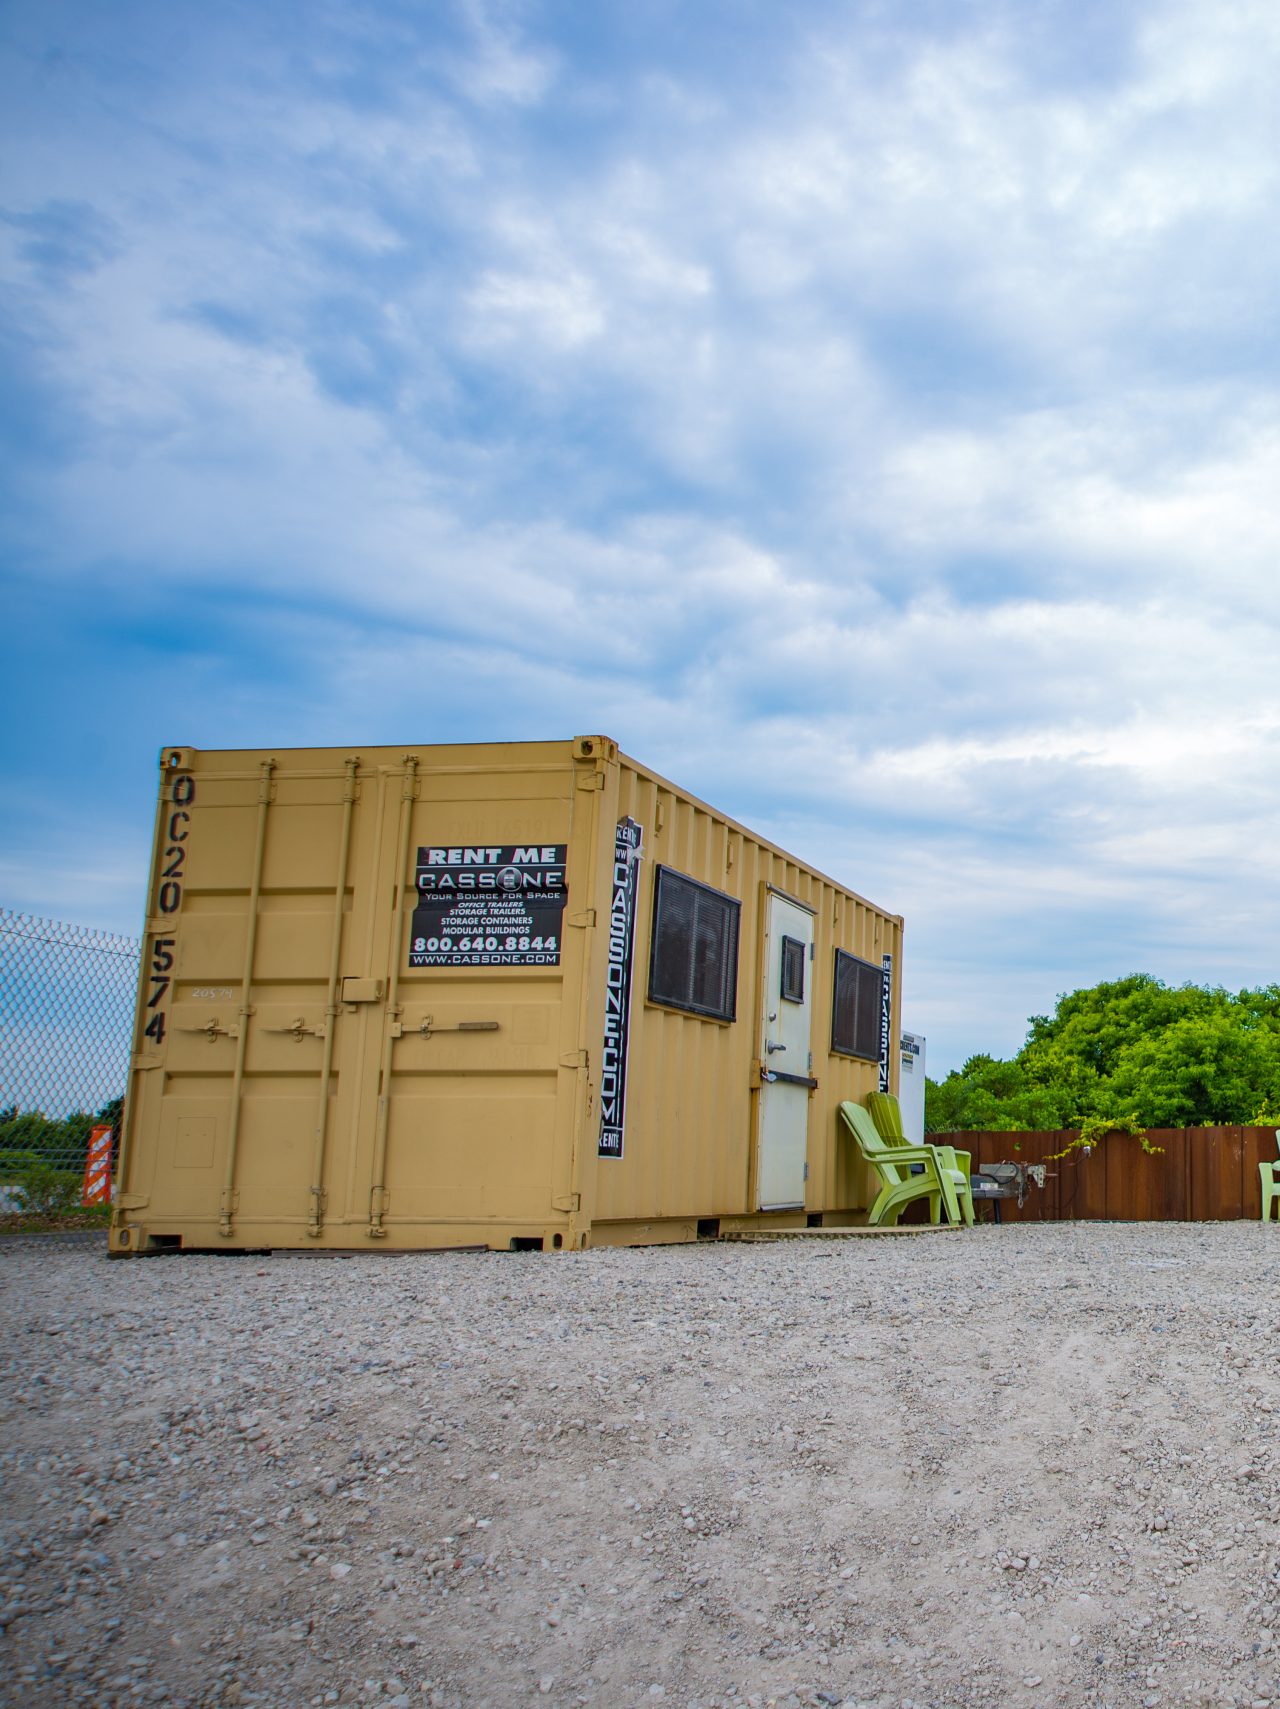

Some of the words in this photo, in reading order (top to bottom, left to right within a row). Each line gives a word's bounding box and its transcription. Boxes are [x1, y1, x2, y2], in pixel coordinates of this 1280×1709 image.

[428, 849, 502, 864] RENT
[512, 848, 556, 863] ME
[440, 917, 479, 925] STORAGE
[480, 917, 533, 925] CONTAINERS
[442, 927, 484, 935] MODULAR
[485, 926, 530, 934] BUILDINGS
[414, 937, 557, 952] 800.640.8844
[413, 955, 557, 964] WWW.CASSONE.COM
[601, 863, 629, 1123] CASSONE.COM
